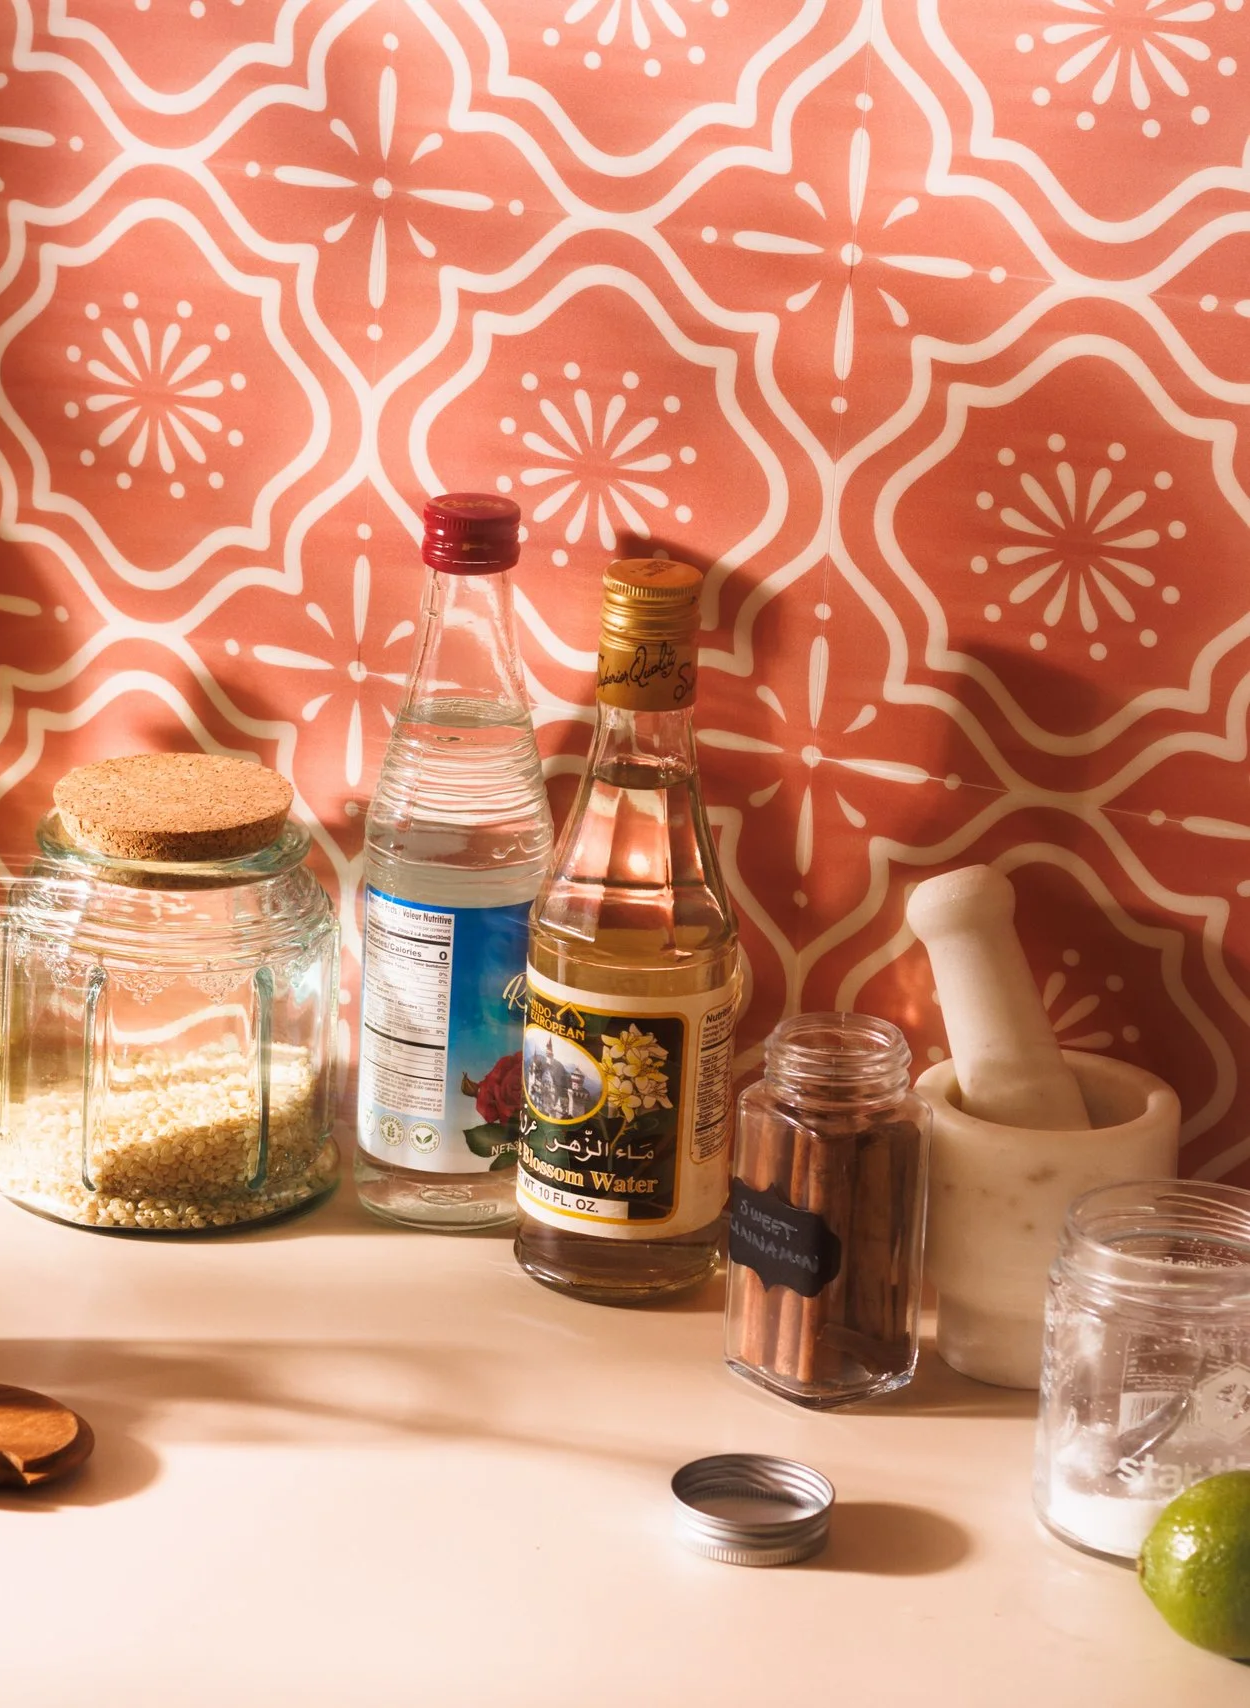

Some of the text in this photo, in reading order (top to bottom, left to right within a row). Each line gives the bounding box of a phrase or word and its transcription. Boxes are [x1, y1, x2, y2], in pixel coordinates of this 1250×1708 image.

[403, 907, 422, 921] Valeur
[423, 912, 452, 926] Nutritive
[439, 950, 448, 961] 0
[531, 996, 556, 1018] INDO-
[530, 1011, 585, 1041] EUROPEAN
[491, 1143, 511, 1156] NET
[522, 1142, 584, 1187] Blossom
[590, 1170, 658, 1193] Water
[538, 1186, 550, 1200] 10
[553, 1192, 571, 1208] FL.
[575, 1199, 599, 1213] OZ.
[740, 1200, 798, 1240] SWEET
